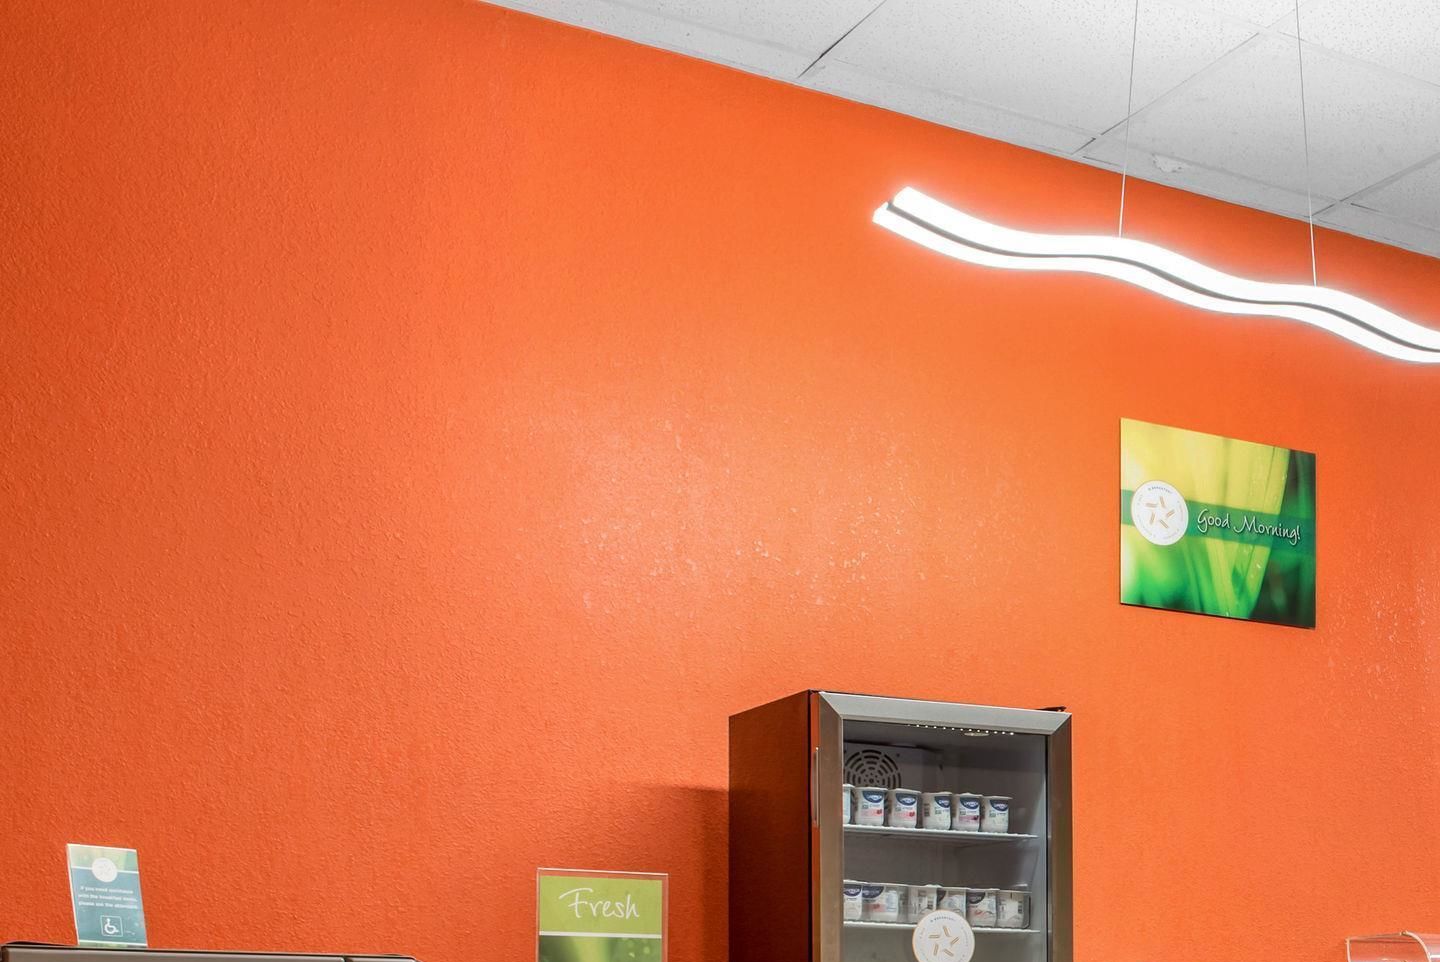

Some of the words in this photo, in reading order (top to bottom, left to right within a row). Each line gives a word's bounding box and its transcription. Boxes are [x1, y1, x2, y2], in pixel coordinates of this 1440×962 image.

[1197, 508, 1231, 534] Good
[1233, 515, 1301, 546] Morning!
[558, 887, 640, 920] Fresh
